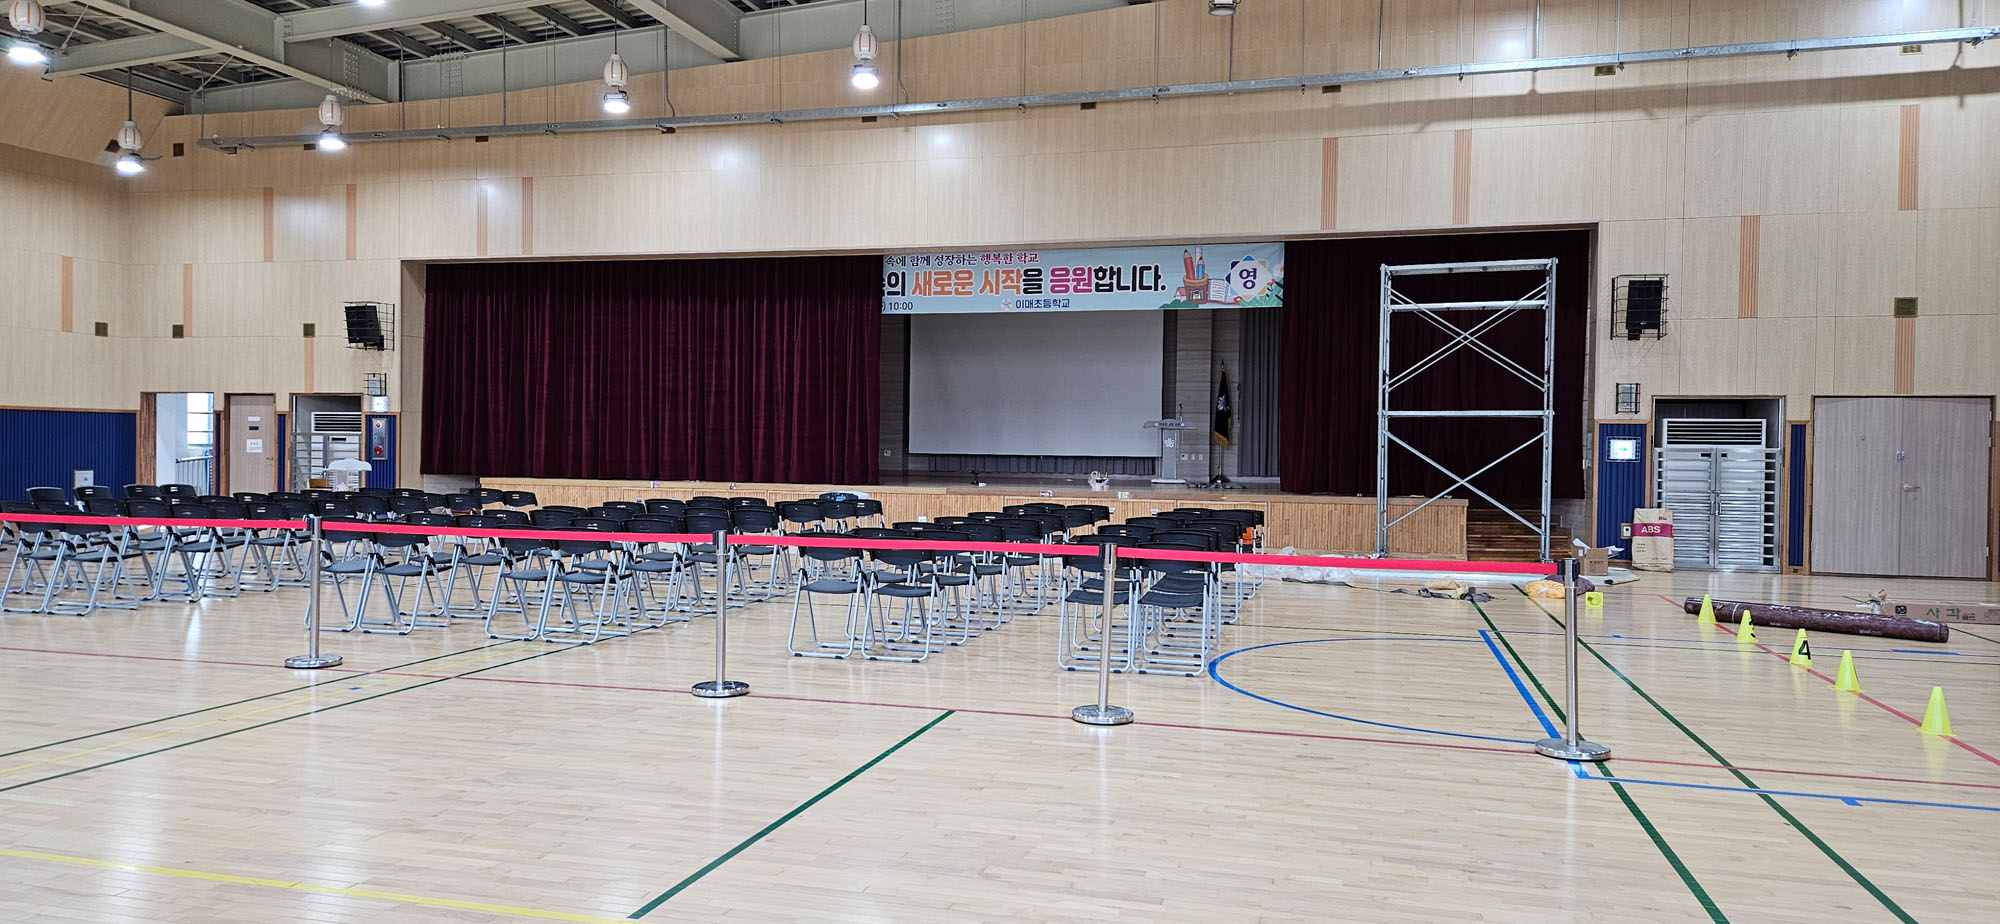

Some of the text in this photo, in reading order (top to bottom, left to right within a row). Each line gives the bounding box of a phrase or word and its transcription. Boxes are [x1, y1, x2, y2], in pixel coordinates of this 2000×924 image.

[885, 252, 1039, 267] 속에 함께 성장하는 행복한 학교
[881, 264, 1167, 296] 의 새로운 시작을 응원합니다.
[1239, 268, 1257, 289] 영
[888, 301, 914, 311] 10:00
[1015, 298, 1070, 309] 이매초등학교
[1640, 525, 1661, 534] ABS
[1798, 639, 1812, 660] 4
